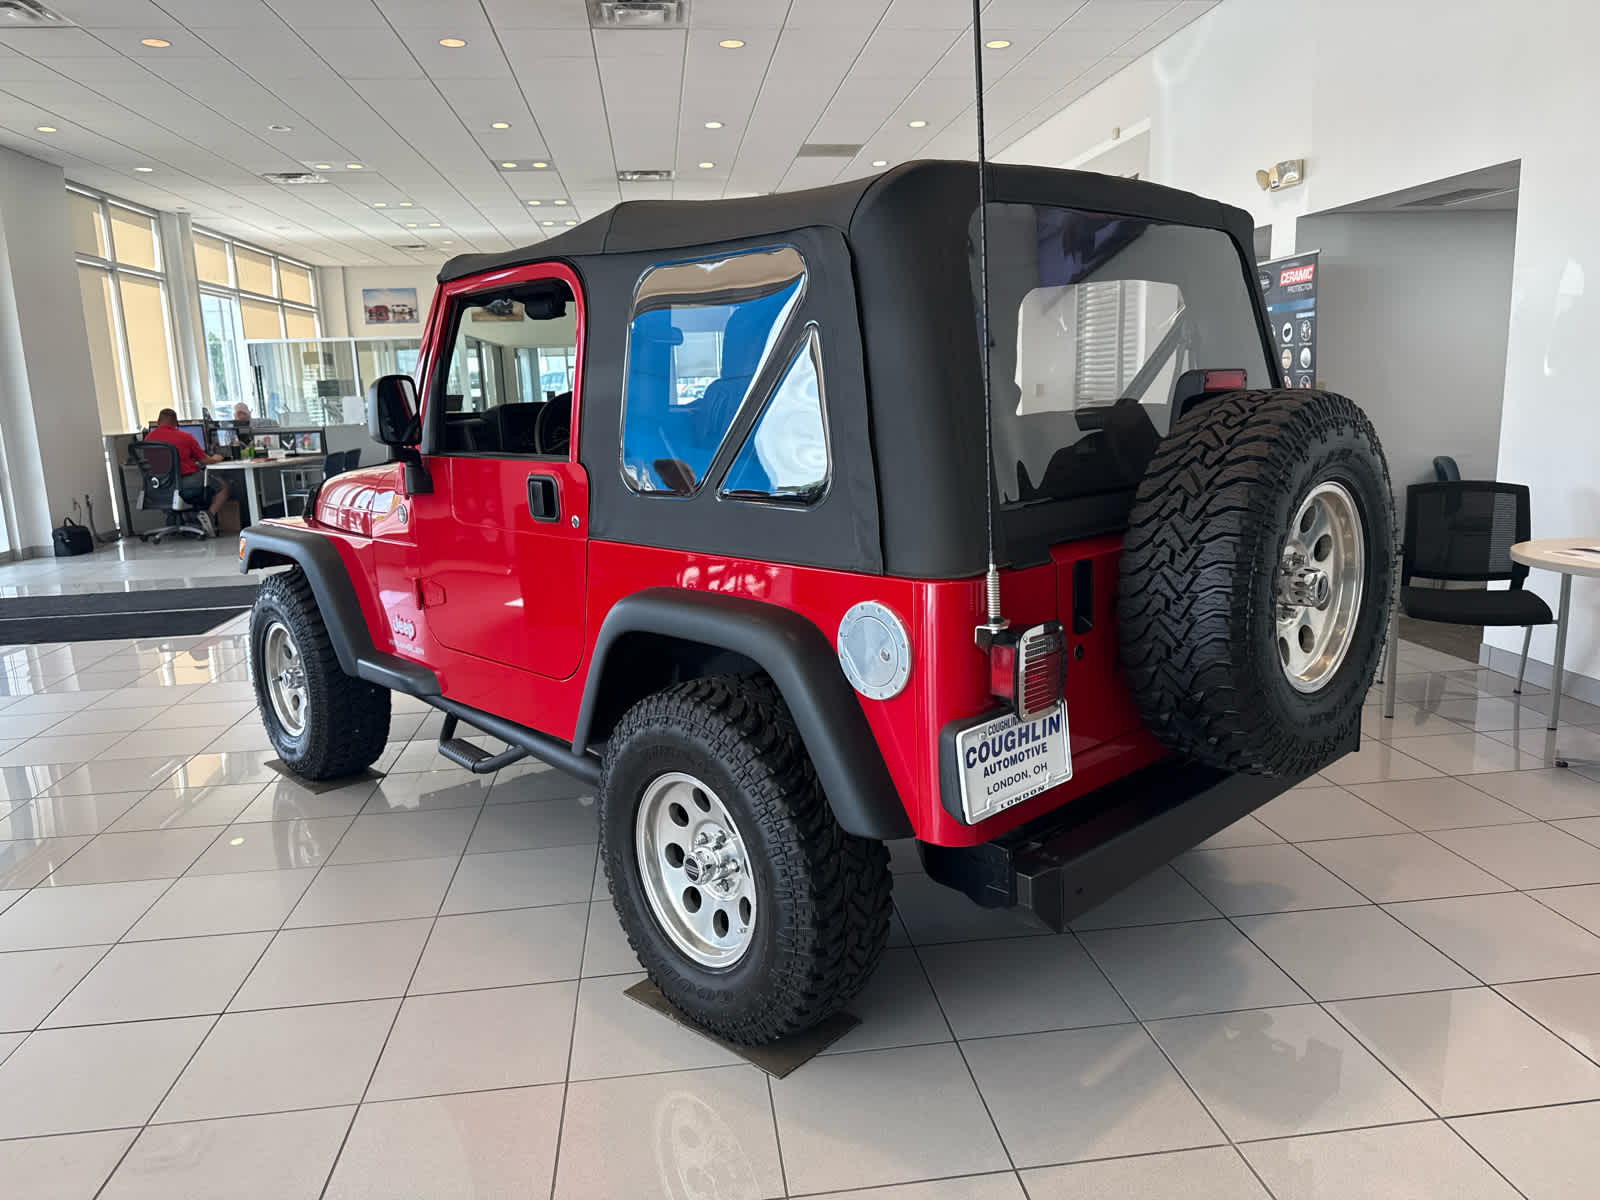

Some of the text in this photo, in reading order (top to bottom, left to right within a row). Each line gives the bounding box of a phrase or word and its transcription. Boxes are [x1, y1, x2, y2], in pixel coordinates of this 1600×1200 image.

[1280, 267, 1313, 284] CERAMIC
[392, 614, 416, 641] Jeep
[965, 713, 1061, 769] COUGHLIN
[983, 742, 1048, 778] AUTOMOTIVE
[987, 762, 1048, 796] LONDON, OH
[1000, 785, 1046, 809] LONDON
